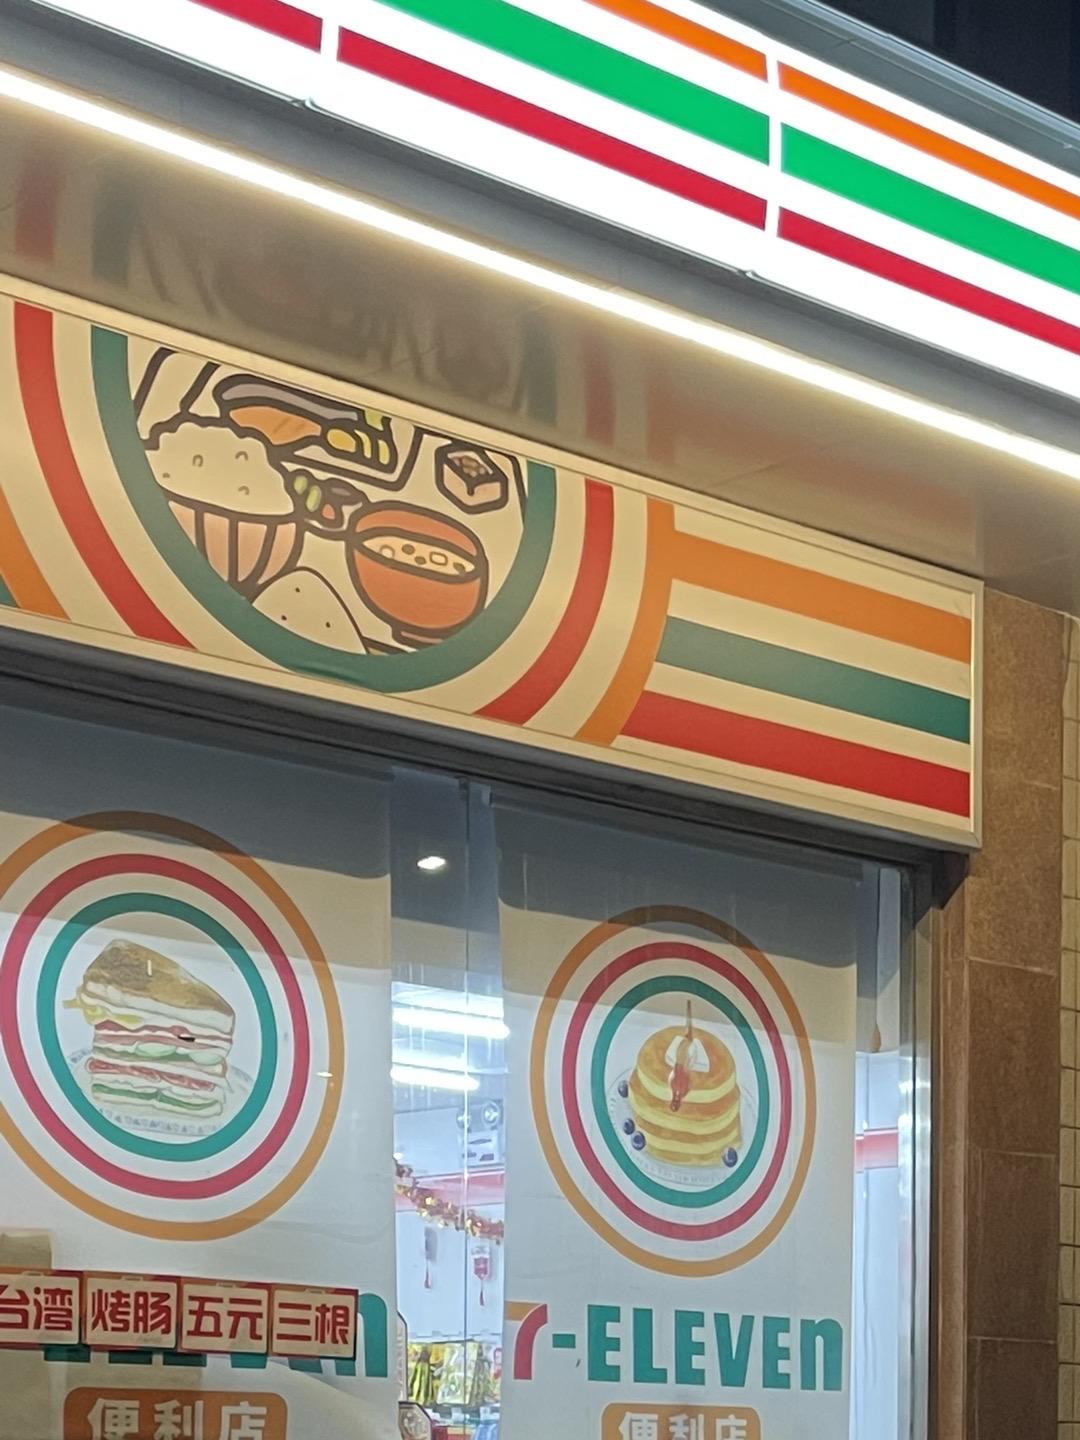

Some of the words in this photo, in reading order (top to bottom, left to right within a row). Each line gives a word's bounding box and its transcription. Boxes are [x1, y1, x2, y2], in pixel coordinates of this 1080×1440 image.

[0, 1286, 351, 1346] 台湾烤肠五元三根
